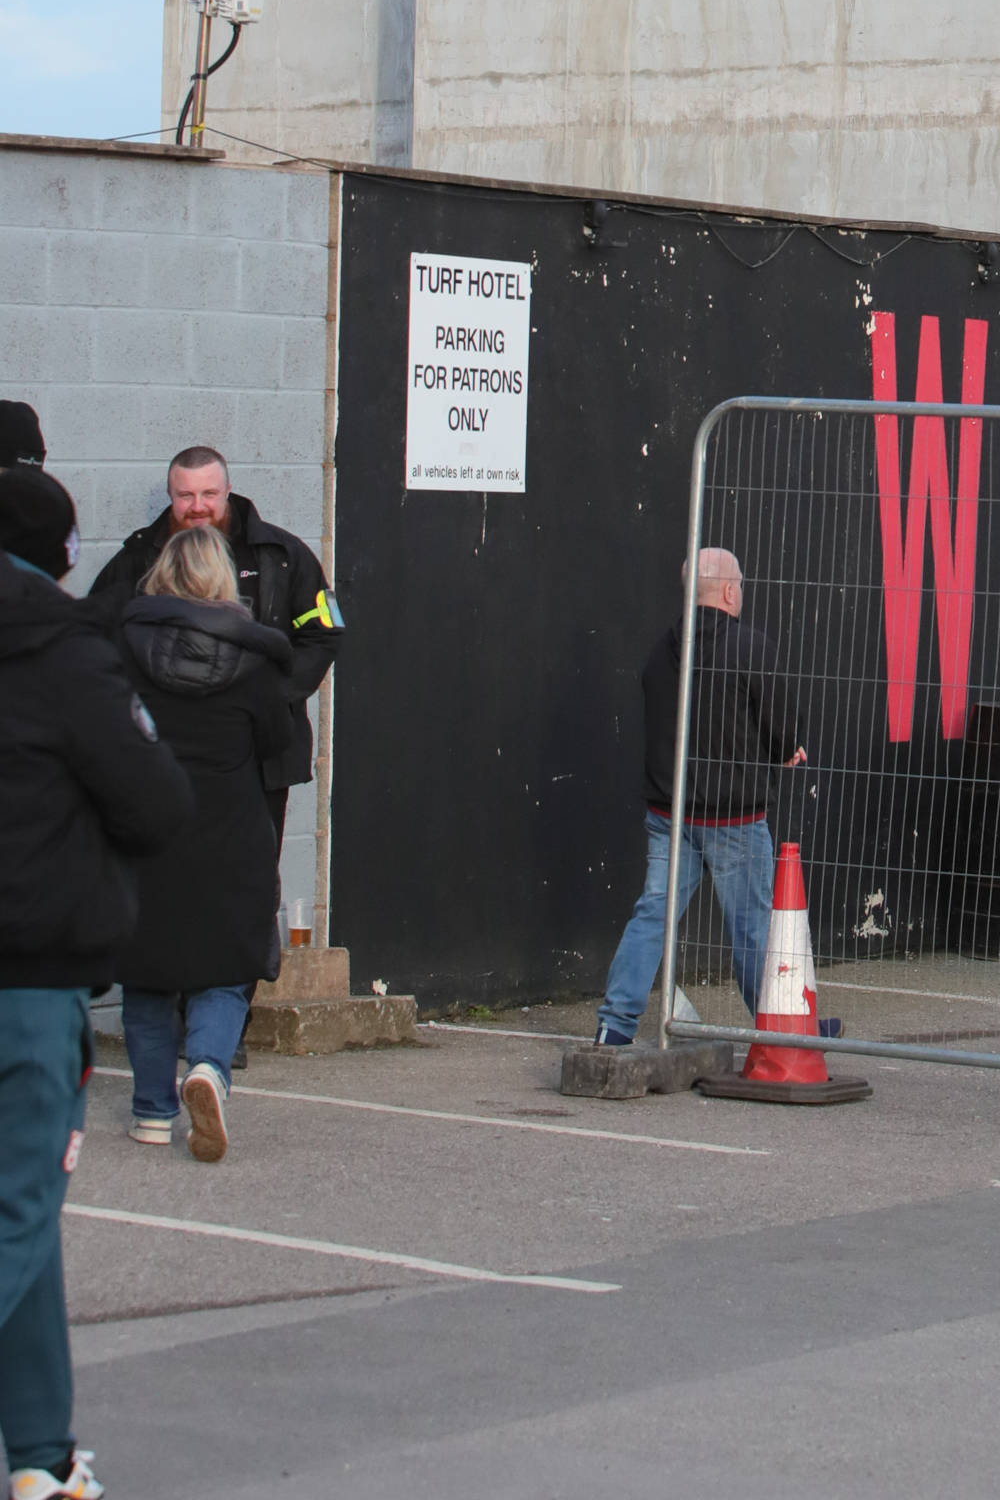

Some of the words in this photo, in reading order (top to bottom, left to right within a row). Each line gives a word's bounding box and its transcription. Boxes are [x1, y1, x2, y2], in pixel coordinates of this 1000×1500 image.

[416, 265, 463, 295] TURF
[469, 270, 525, 300] HOTEL
[436, 326, 505, 354] PARKING
[414, 365, 447, 389] FOR
[452, 367, 522, 394] PATRONS
[449, 407, 488, 431] ONLY
[412, 465, 421, 477] all
[425, 465, 457, 479] vehicles
[460, 466, 473, 479] left
[476, 468, 484, 479] at
[486, 470, 503, 480] own
[505, 467, 520, 481] risk
